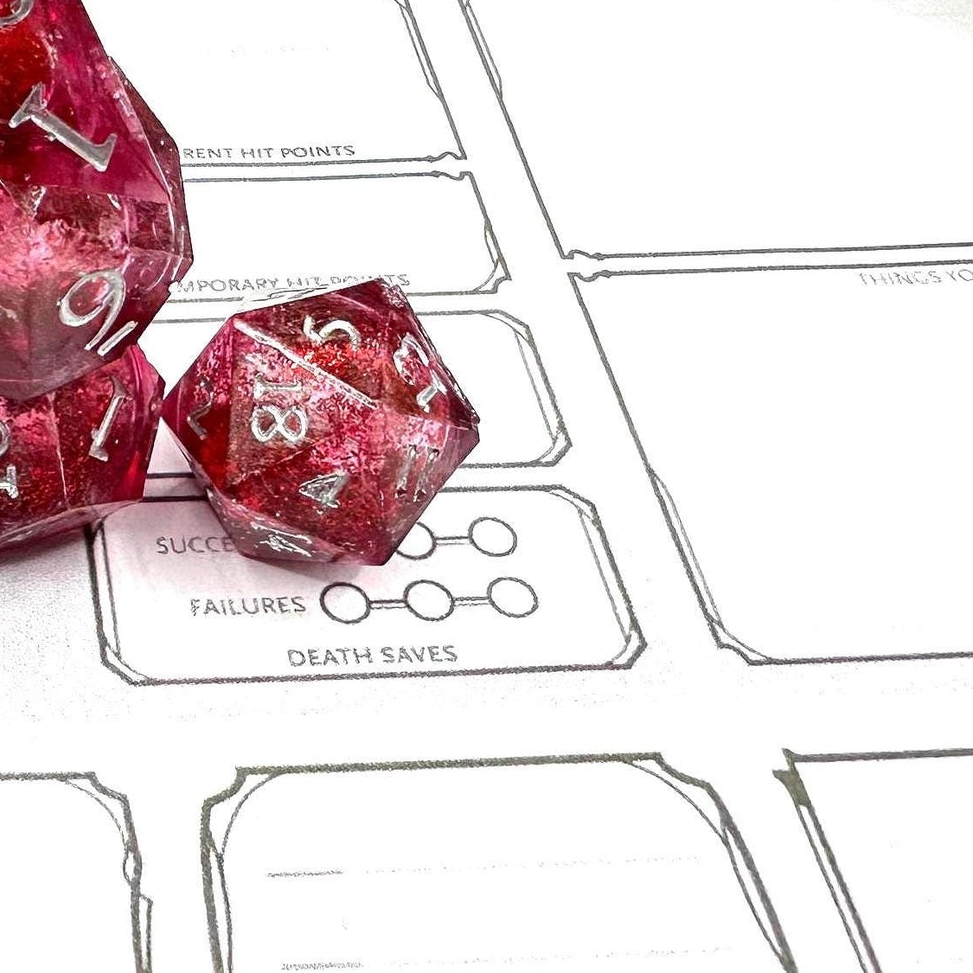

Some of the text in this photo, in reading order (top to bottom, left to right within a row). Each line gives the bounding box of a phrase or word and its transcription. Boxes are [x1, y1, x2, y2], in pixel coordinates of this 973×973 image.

[8, 83, 118, 173] 1
[241, 148, 274, 159] HIT
[281, 145, 355, 158] POINTS
[858, 270, 942, 286] THINGS
[250, 372, 309, 445] 18
[191, 596, 306, 616] FAILURES
[287, 645, 459, 667] DEATH SAVES
